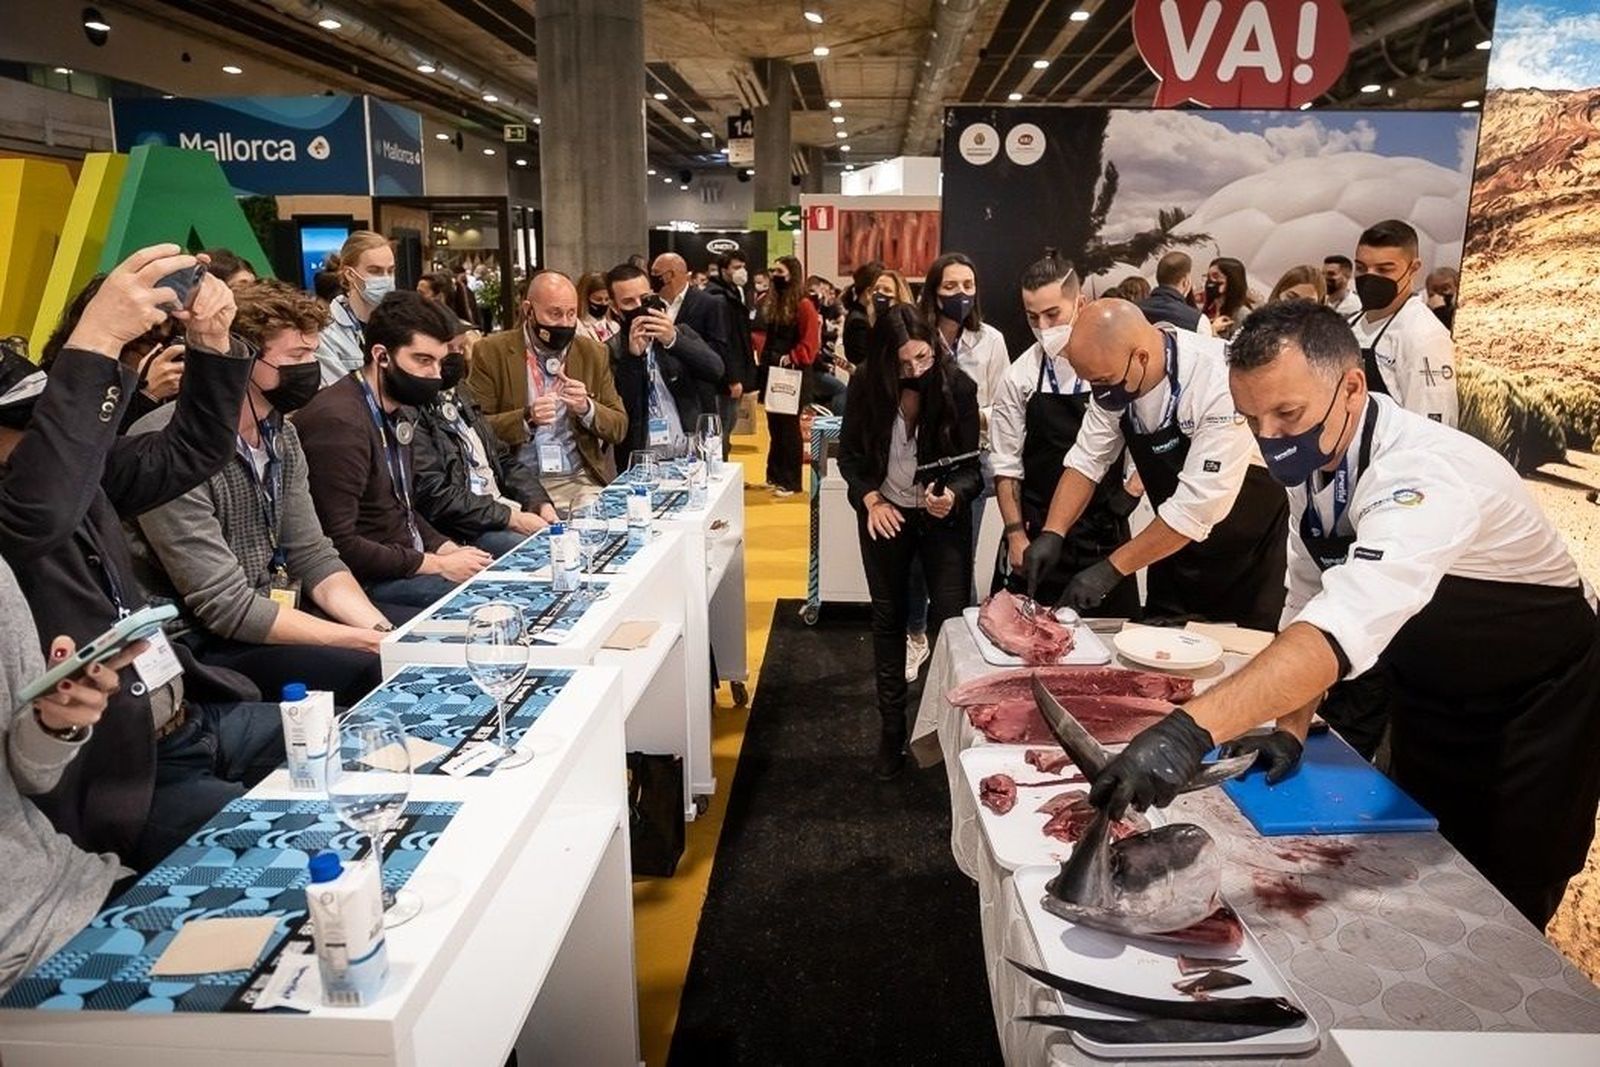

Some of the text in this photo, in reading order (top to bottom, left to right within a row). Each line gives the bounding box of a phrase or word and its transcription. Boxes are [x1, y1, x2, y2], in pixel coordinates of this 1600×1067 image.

[1160, 0, 1318, 85] VA!
[734, 119, 753, 136] 14
[179, 132, 296, 161] Mallorca
[383, 139, 414, 165] Mallorca
